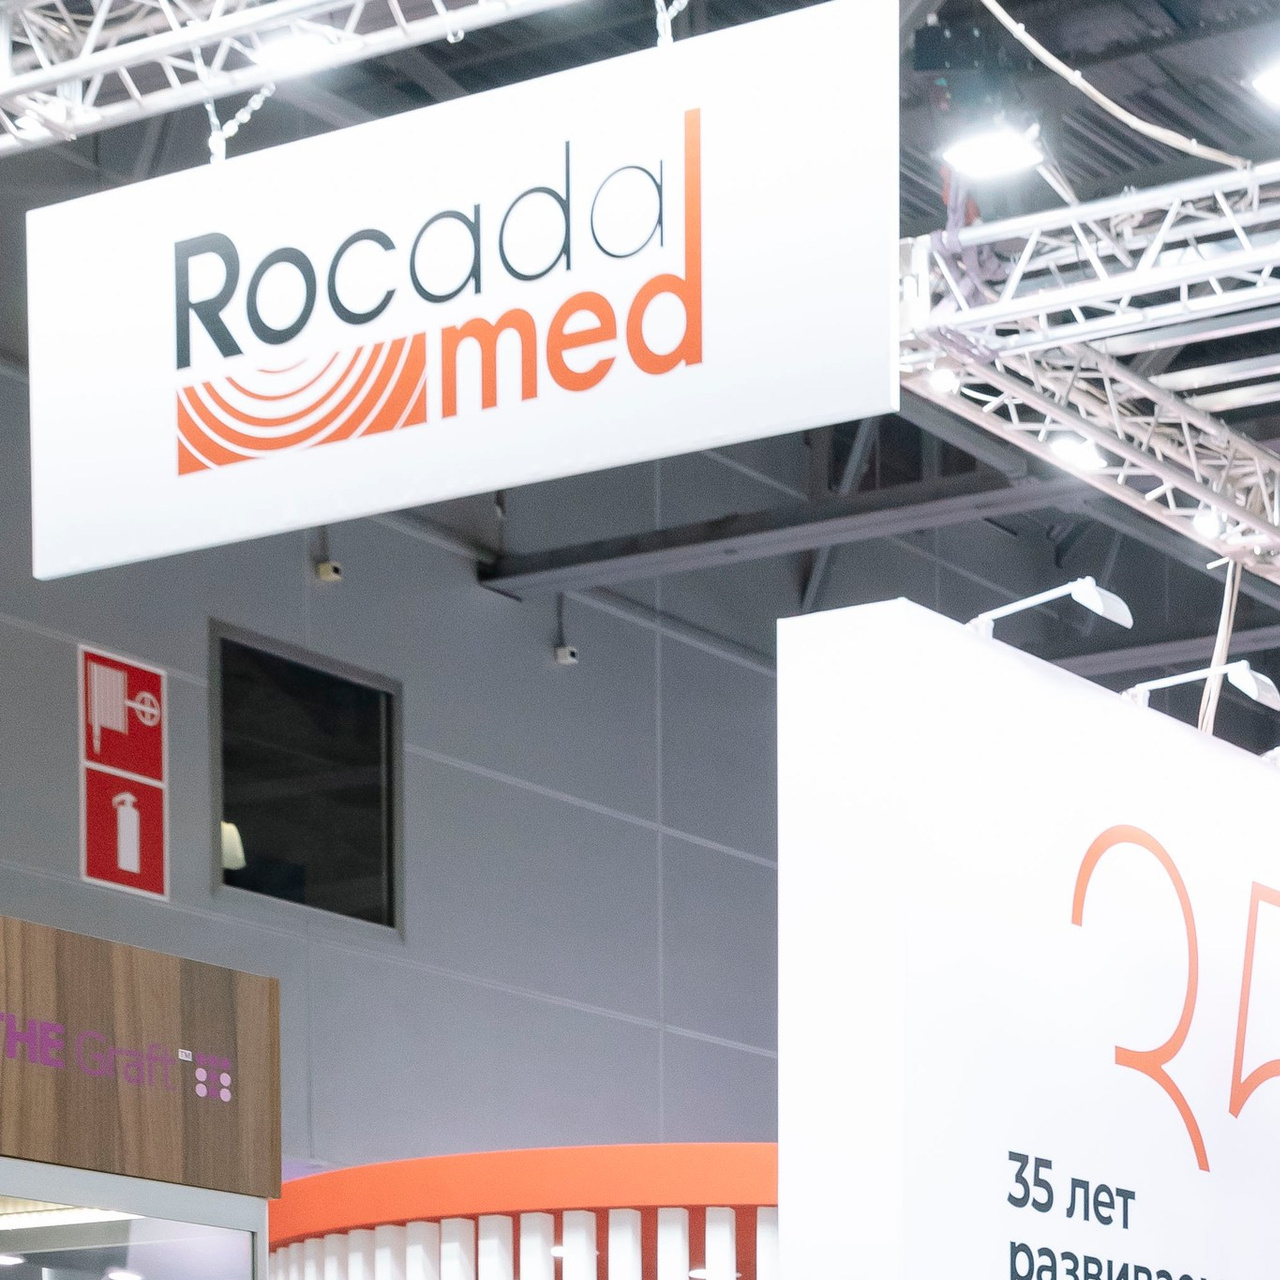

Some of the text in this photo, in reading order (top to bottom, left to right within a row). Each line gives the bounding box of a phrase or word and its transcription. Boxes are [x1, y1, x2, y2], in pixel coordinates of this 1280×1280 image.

[174, 140, 665, 370] Rocada
[441, 107, 704, 419] med
[74, 1029, 178, 1093] Graft
[1007, 1150, 1136, 1230] 35 лет
